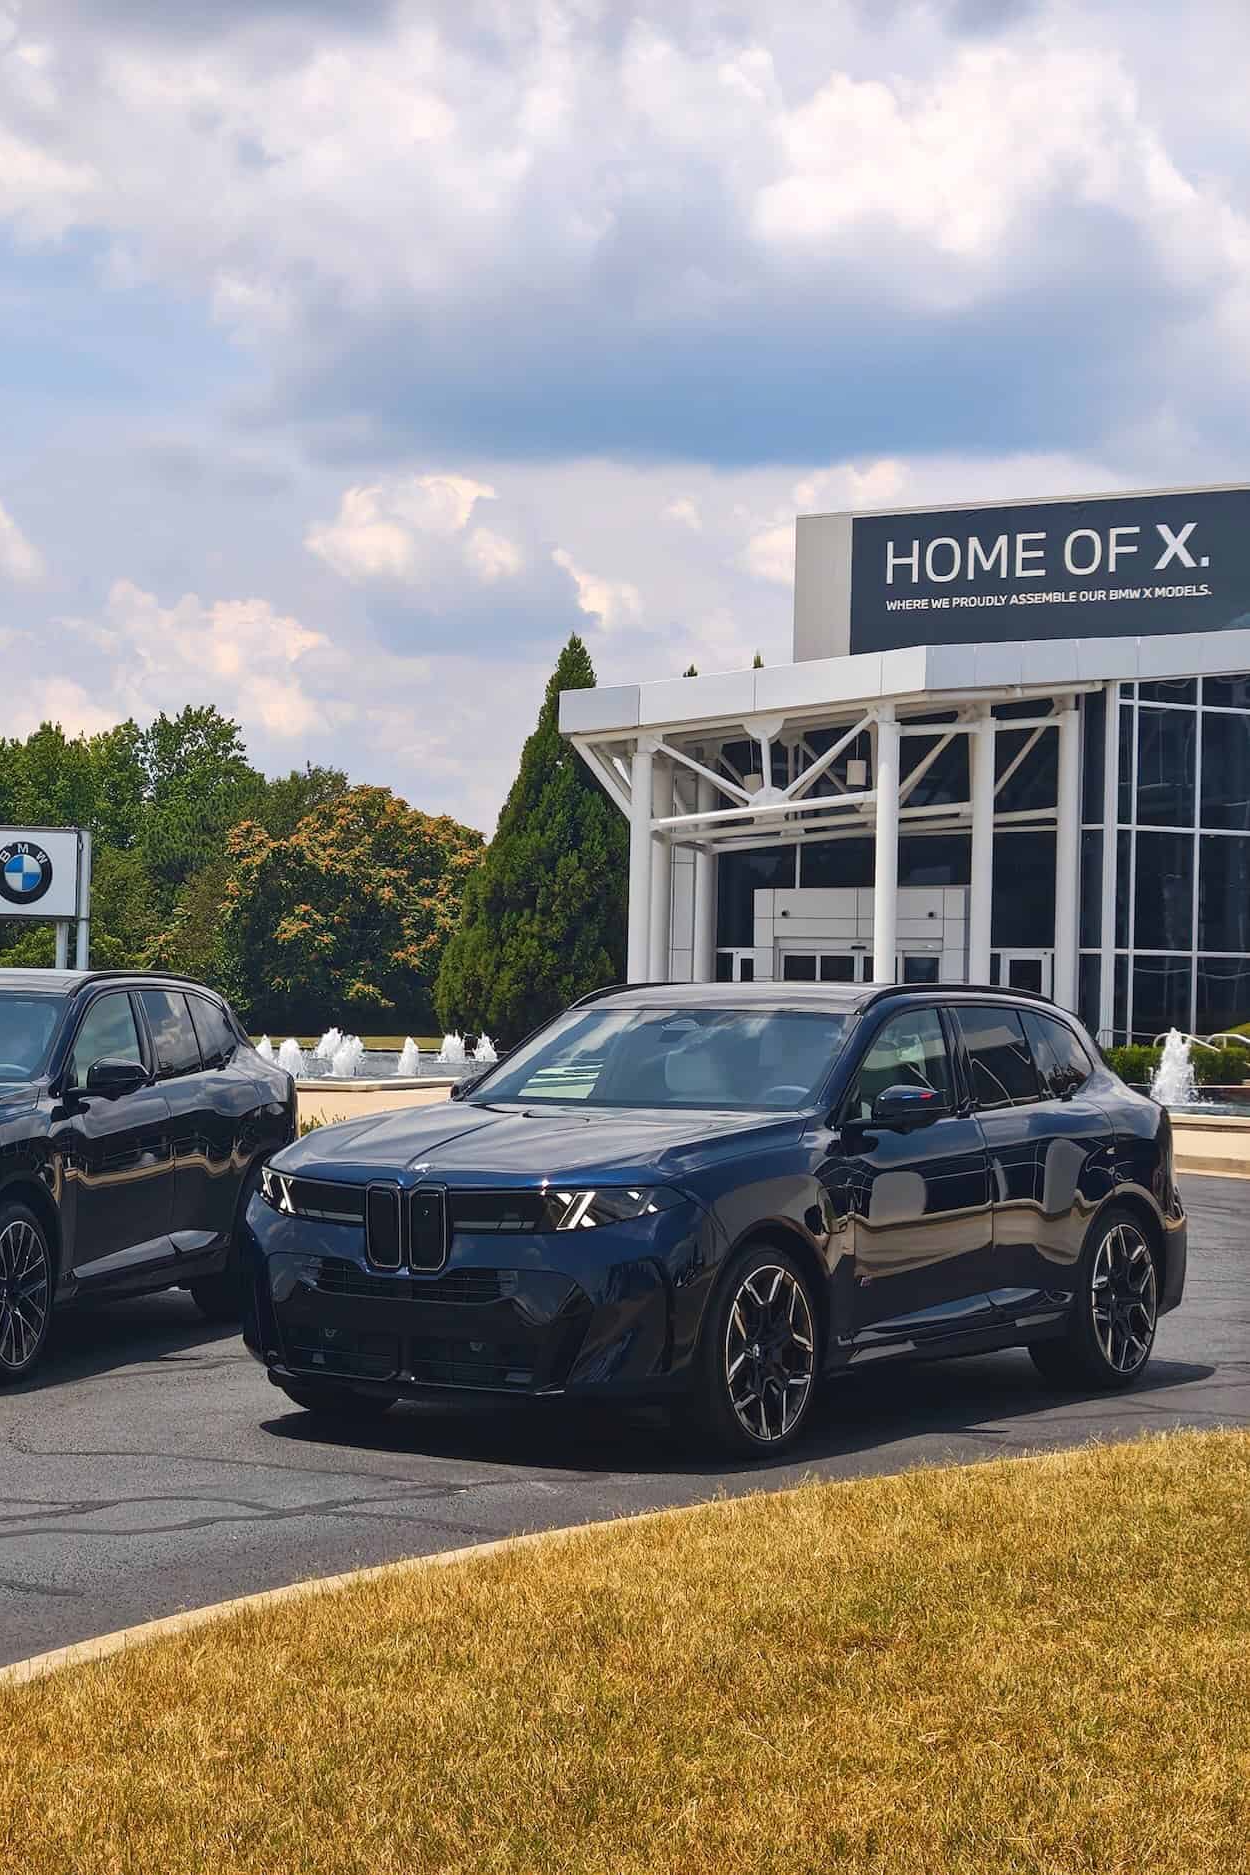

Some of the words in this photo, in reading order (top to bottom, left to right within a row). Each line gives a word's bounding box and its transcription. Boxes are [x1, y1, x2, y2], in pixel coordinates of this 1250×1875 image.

[886, 532, 1046, 584] HOME
[1064, 526, 1141, 575] OF
[1153, 522, 1211, 570] X.
[886, 599, 929, 611] WHERE
[931, 597, 950, 610] WE
[952, 594, 1008, 608] PROUDLY
[1009, 590, 1077, 604] ASSEMBLE
[1079, 590, 1107, 602] OUR
[1109, 588, 1141, 601] BMW
[1142, 587, 1153, 599] X
[1154, 584, 1213, 599] MODELS.
